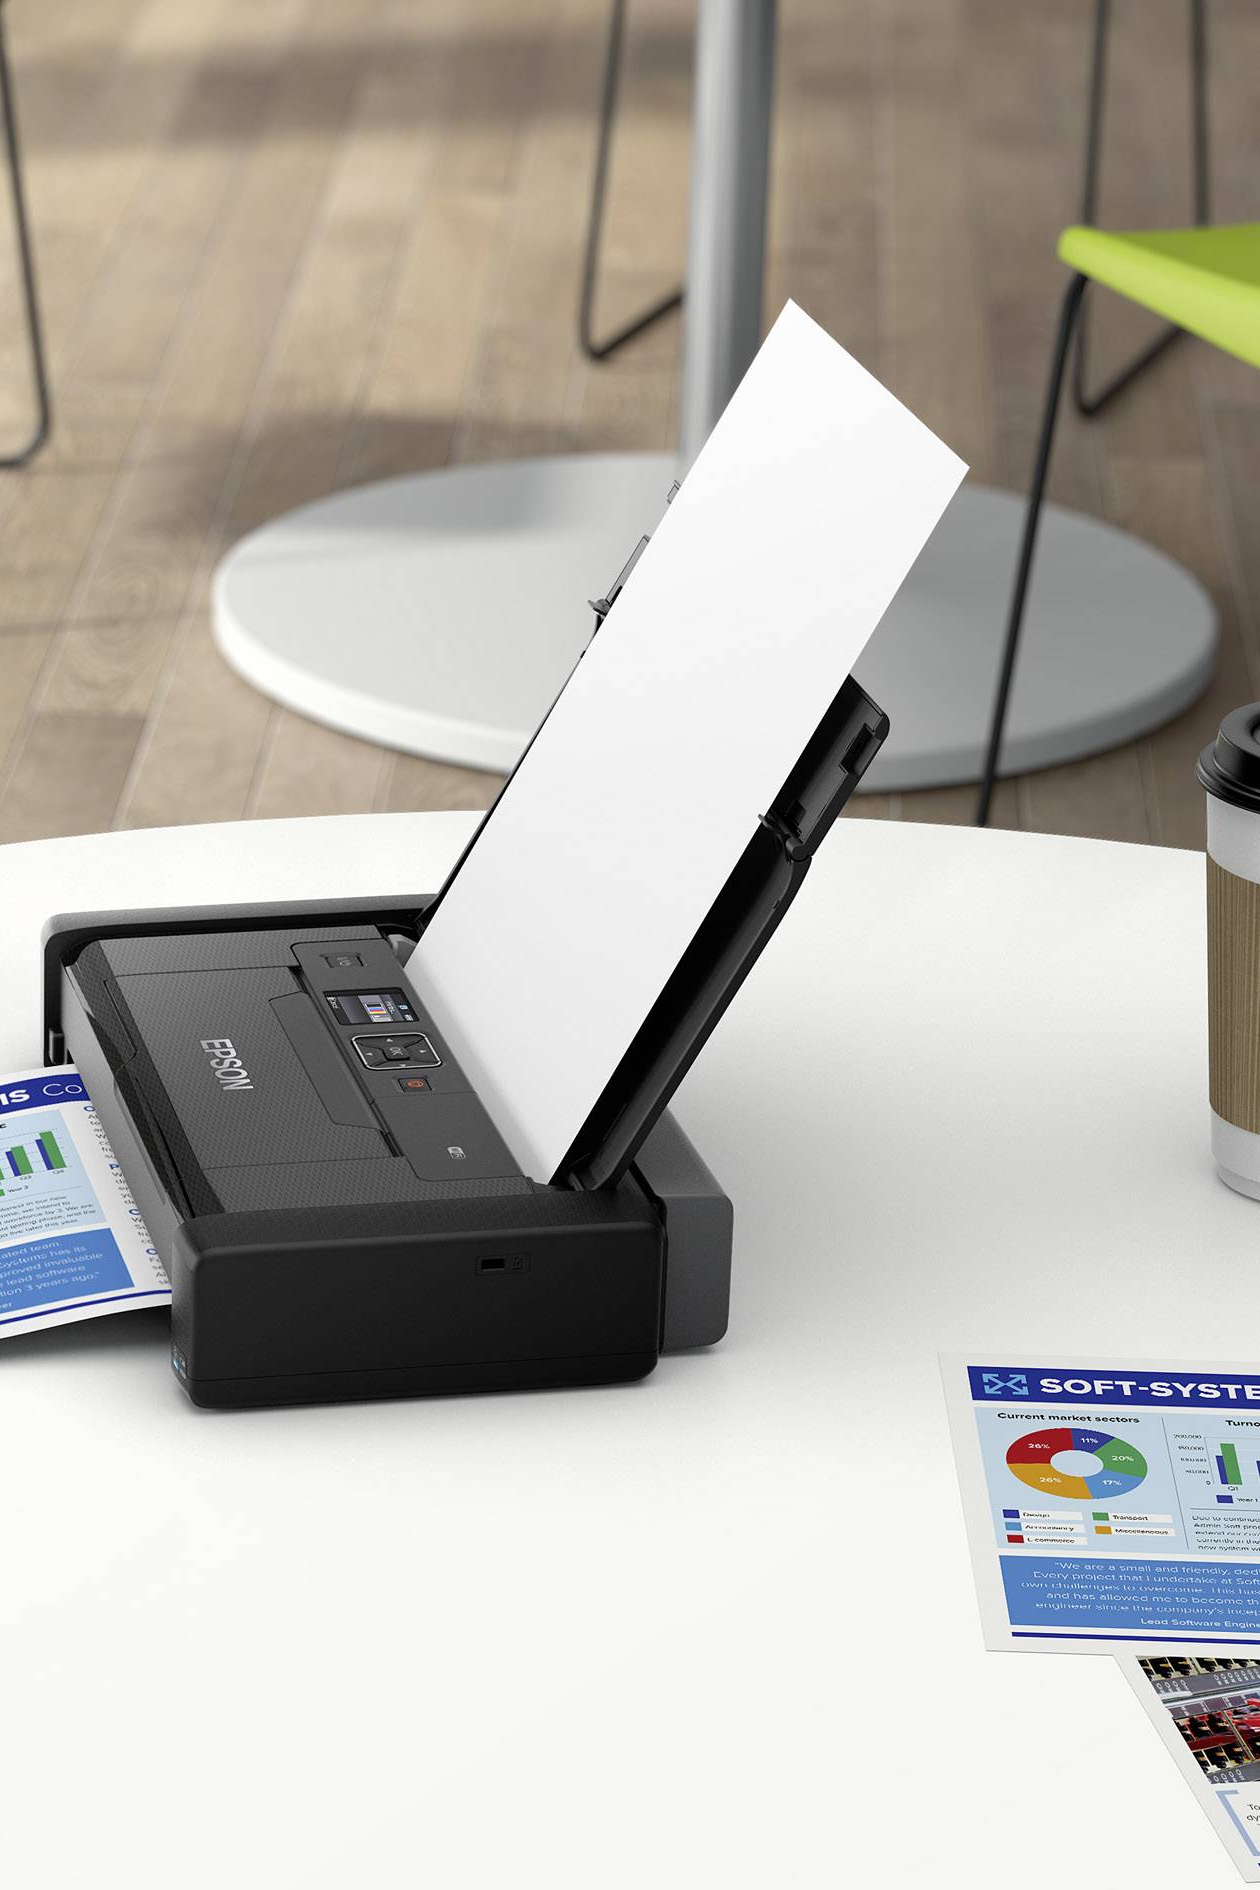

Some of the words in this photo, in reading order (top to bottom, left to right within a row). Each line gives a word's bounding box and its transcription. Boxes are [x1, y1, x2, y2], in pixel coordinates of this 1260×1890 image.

[200, 1038, 254, 1091] EPSON
[997, 1411, 1045, 1421] Current
[1047, 1414, 1092, 1422] market
[1094, 1416, 1140, 1424] sectors
[1039, 1476, 1062, 1484] 26%
